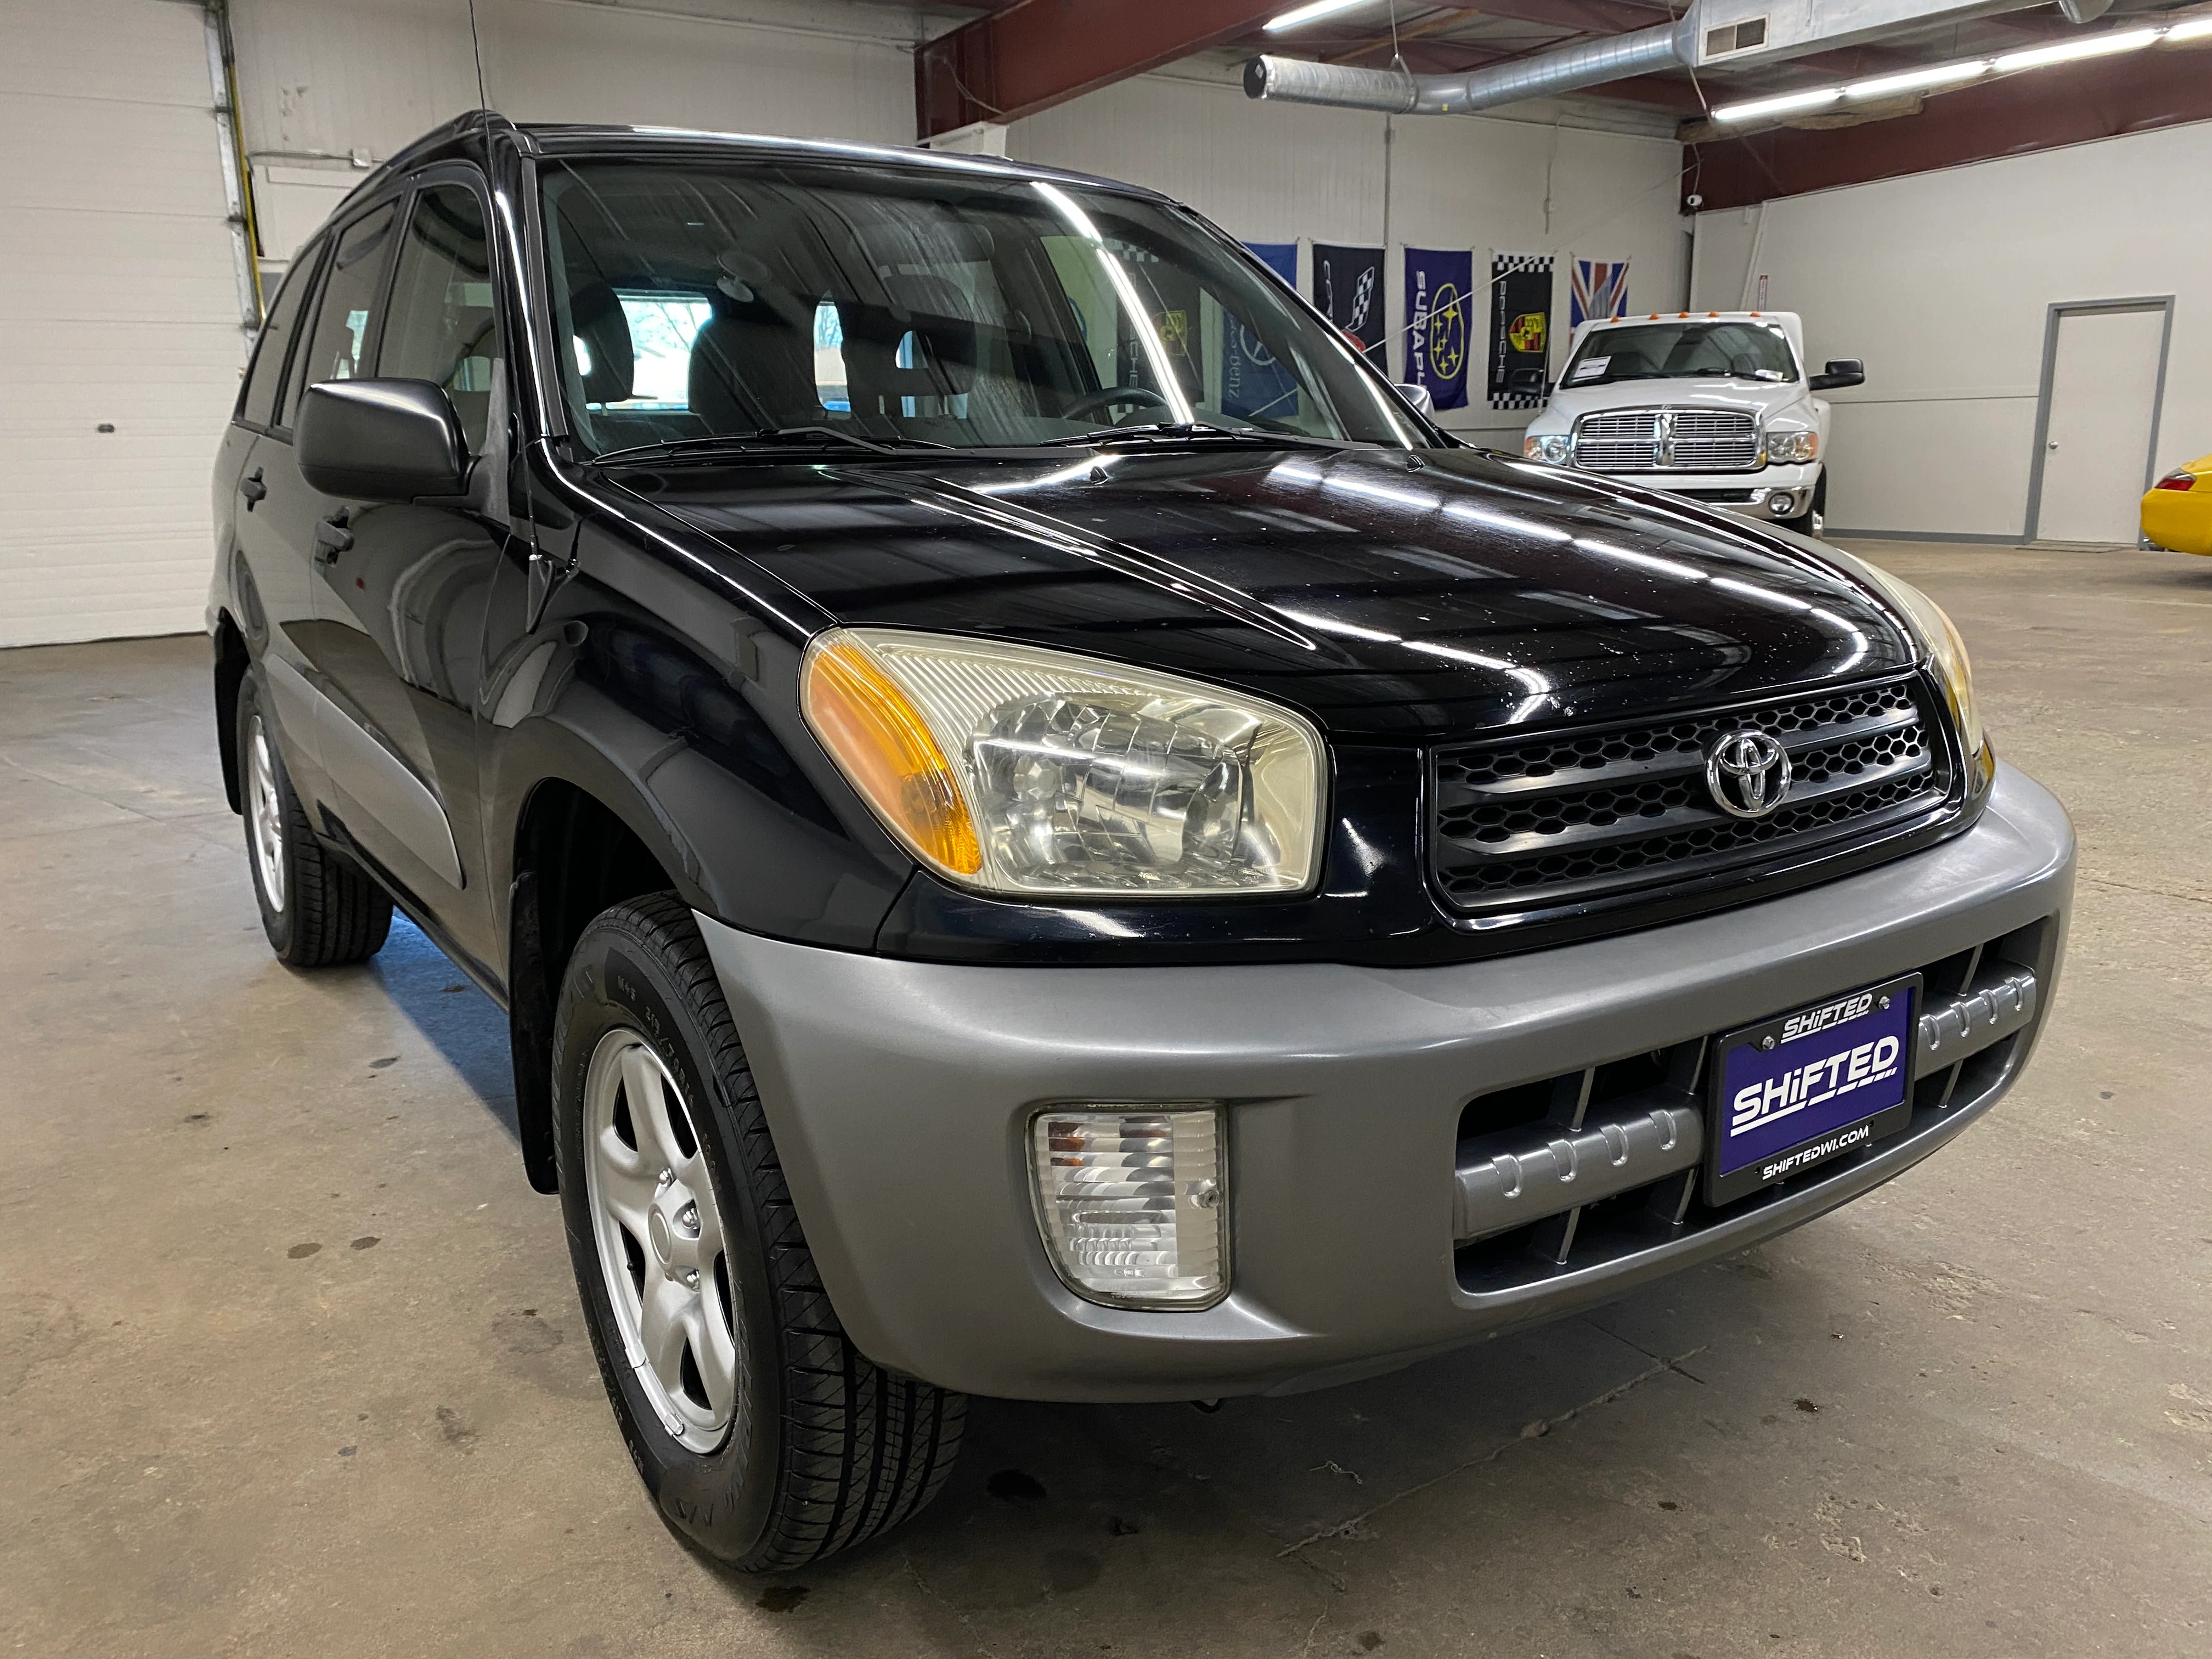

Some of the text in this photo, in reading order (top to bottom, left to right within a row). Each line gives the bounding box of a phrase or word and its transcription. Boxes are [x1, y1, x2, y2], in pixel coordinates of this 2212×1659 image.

[1413, 270, 1428, 385] SUBARU
[1496, 281, 1507, 383] PORSCHE
[1762, 1125, 1869, 1180] SHIFTEDWI.COM
